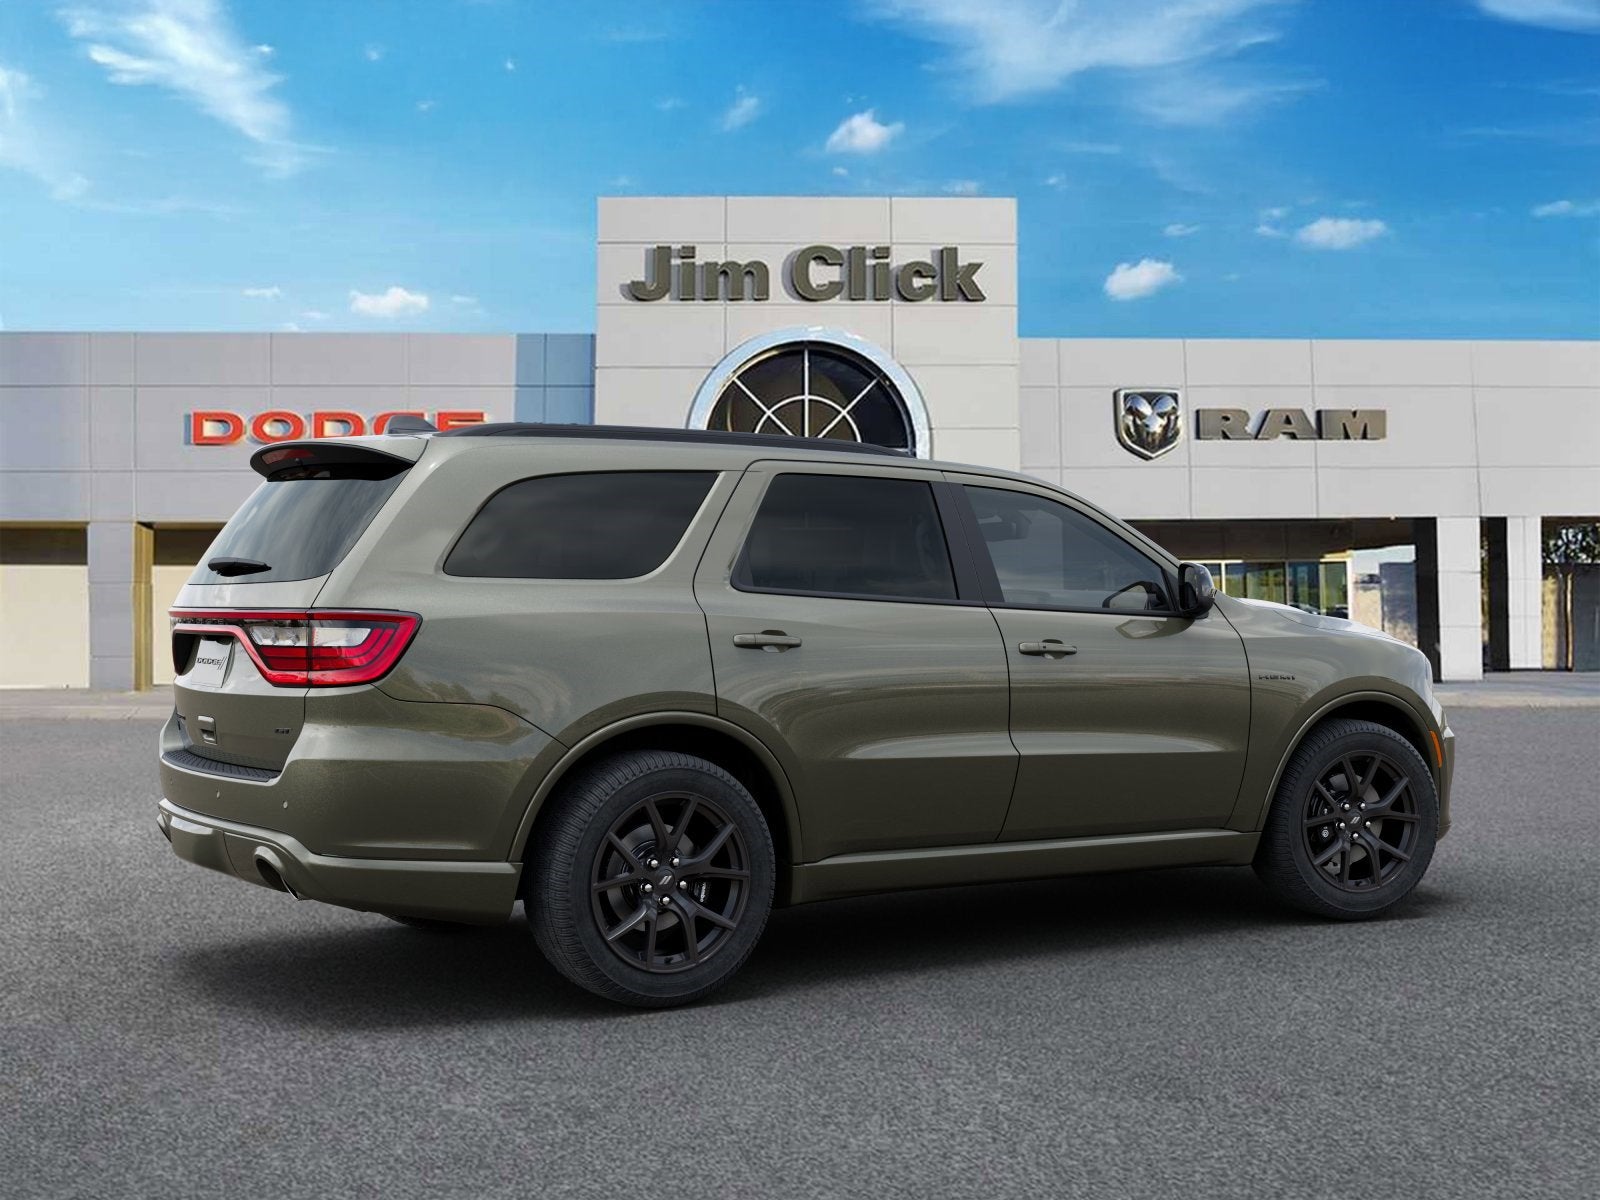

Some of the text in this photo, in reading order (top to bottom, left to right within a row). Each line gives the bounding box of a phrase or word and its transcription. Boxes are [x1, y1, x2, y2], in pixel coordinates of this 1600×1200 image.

[626, 245, 987, 301] Jim Click
[1195, 408, 1387, 440] RAM
